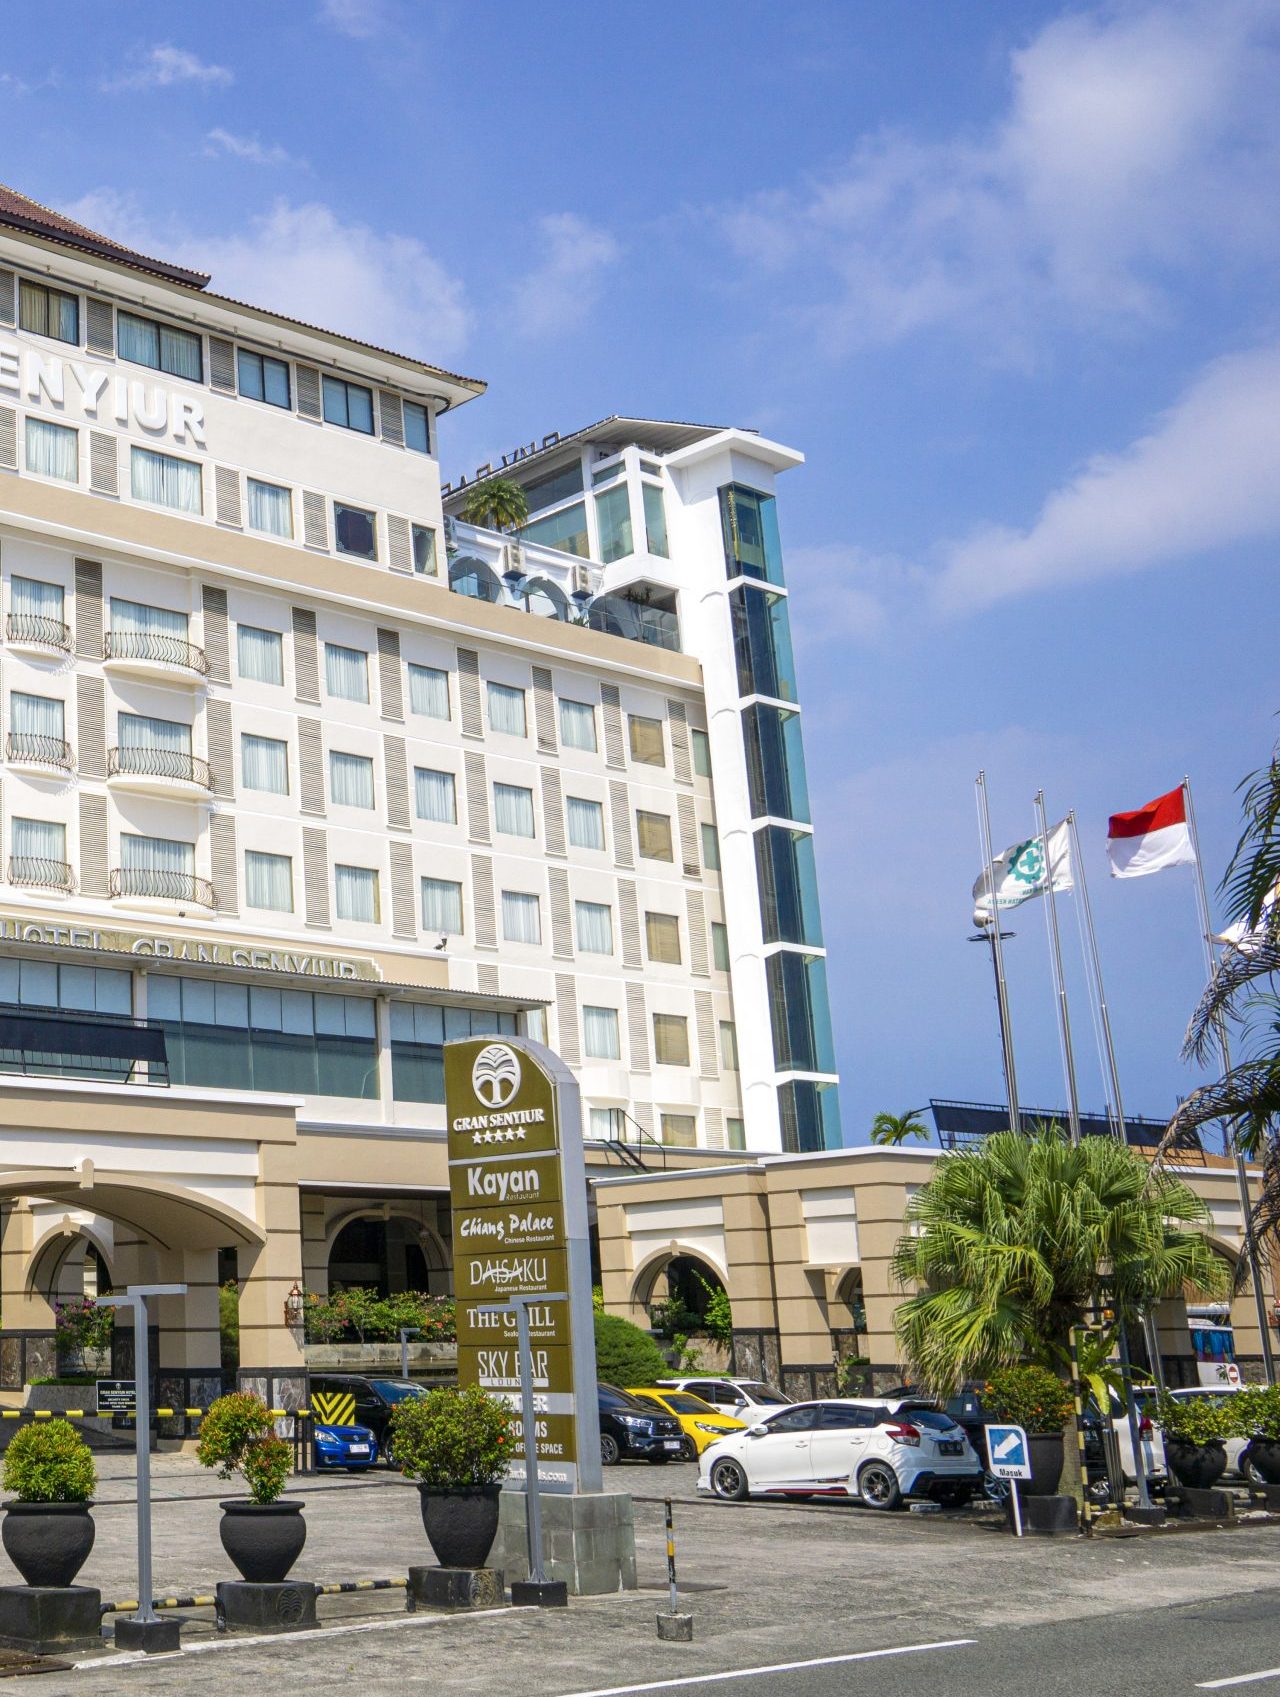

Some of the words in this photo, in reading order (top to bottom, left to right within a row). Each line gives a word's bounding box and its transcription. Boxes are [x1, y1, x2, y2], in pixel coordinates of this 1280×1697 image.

[453, 1115, 488, 1131] GRAN
[489, 1108, 545, 1127] SENYIUR
[467, 1167, 539, 1201] Kayan
[506, 1192, 540, 1200] Restaurant
[460, 1217, 505, 1240] Chiang
[509, 1212, 554, 1233] Palace
[470, 1257, 547, 1285] DAISAKU
[466, 1308, 500, 1328] THE
[503, 1307, 555, 1327] GILL
[478, 1351, 508, 1377] SKY
[508, 1420, 547, 1437] ROMS
[541, 1444, 563, 1454] SPACE
[999, 1468, 1023, 1477] Masuk
